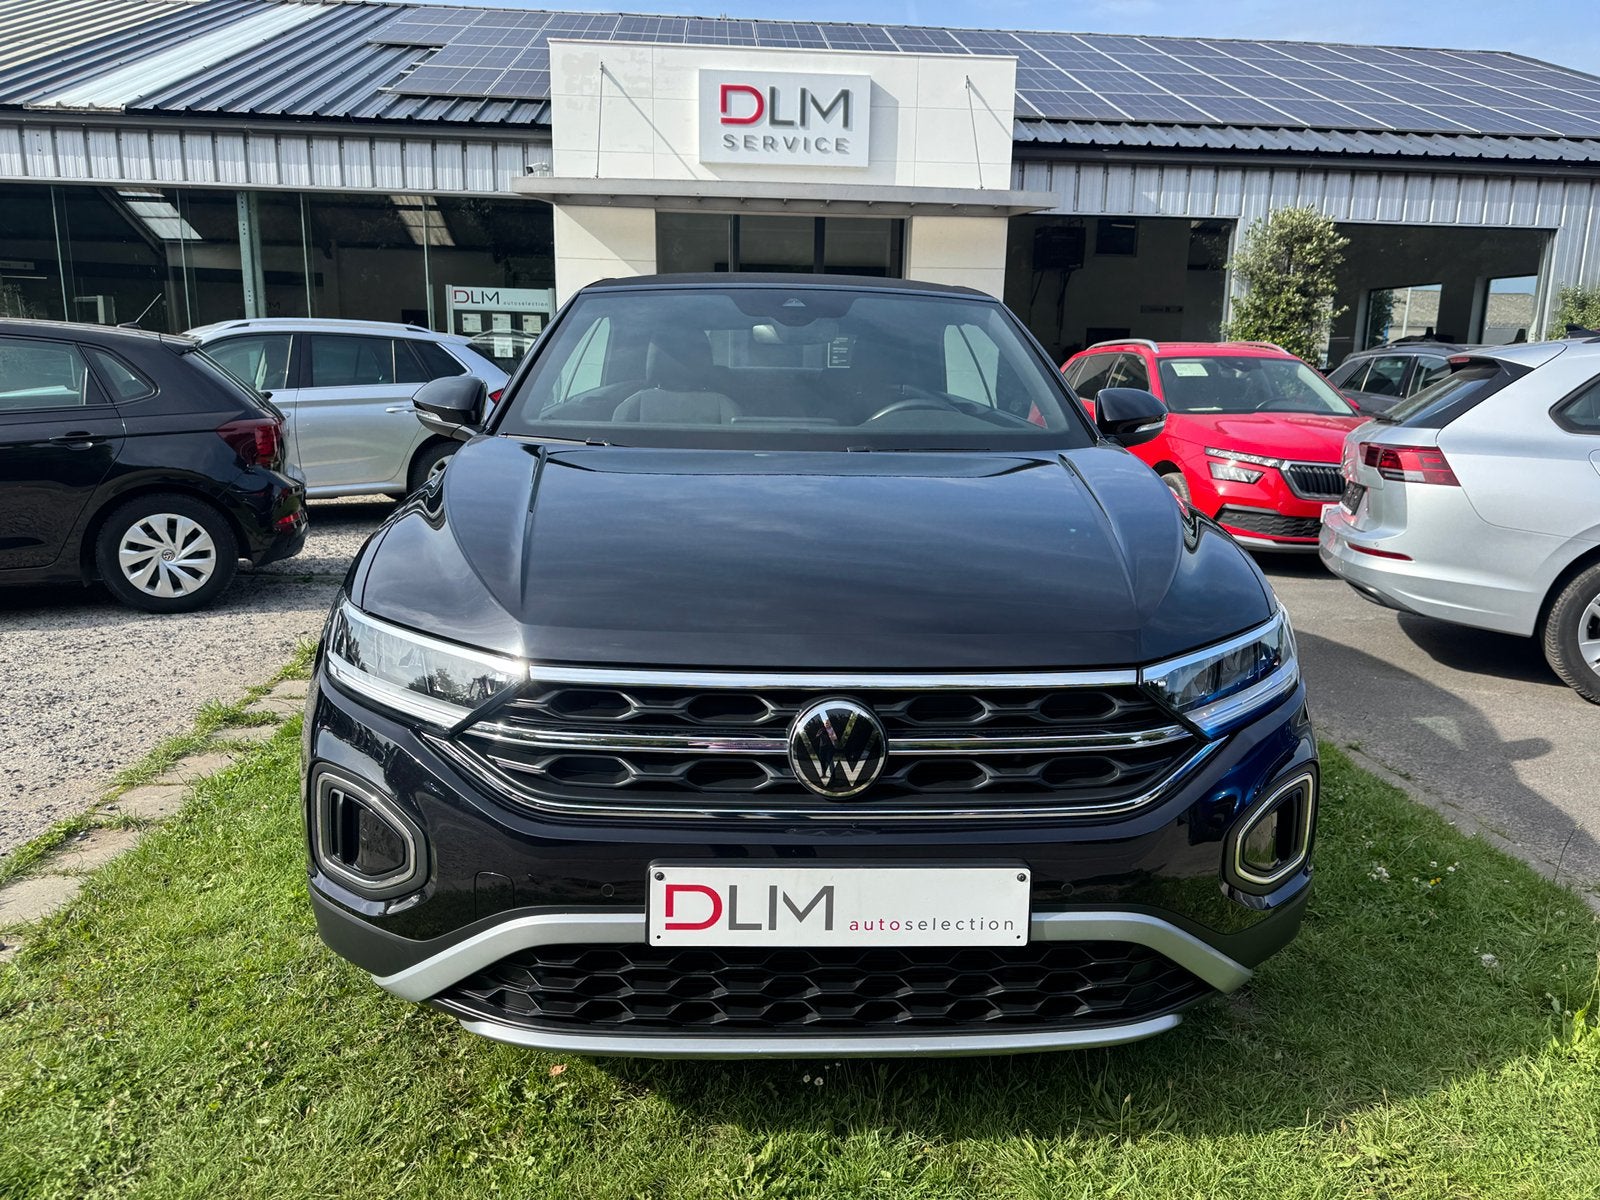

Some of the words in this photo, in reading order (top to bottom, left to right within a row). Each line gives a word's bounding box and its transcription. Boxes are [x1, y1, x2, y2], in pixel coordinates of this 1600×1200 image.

[720, 84, 850, 128] DLM
[722, 134, 850, 153] SERVICE
[454, 290, 499, 304] DLM
[665, 884, 835, 931] DLM
[849, 917, 1014, 931] autoselection
